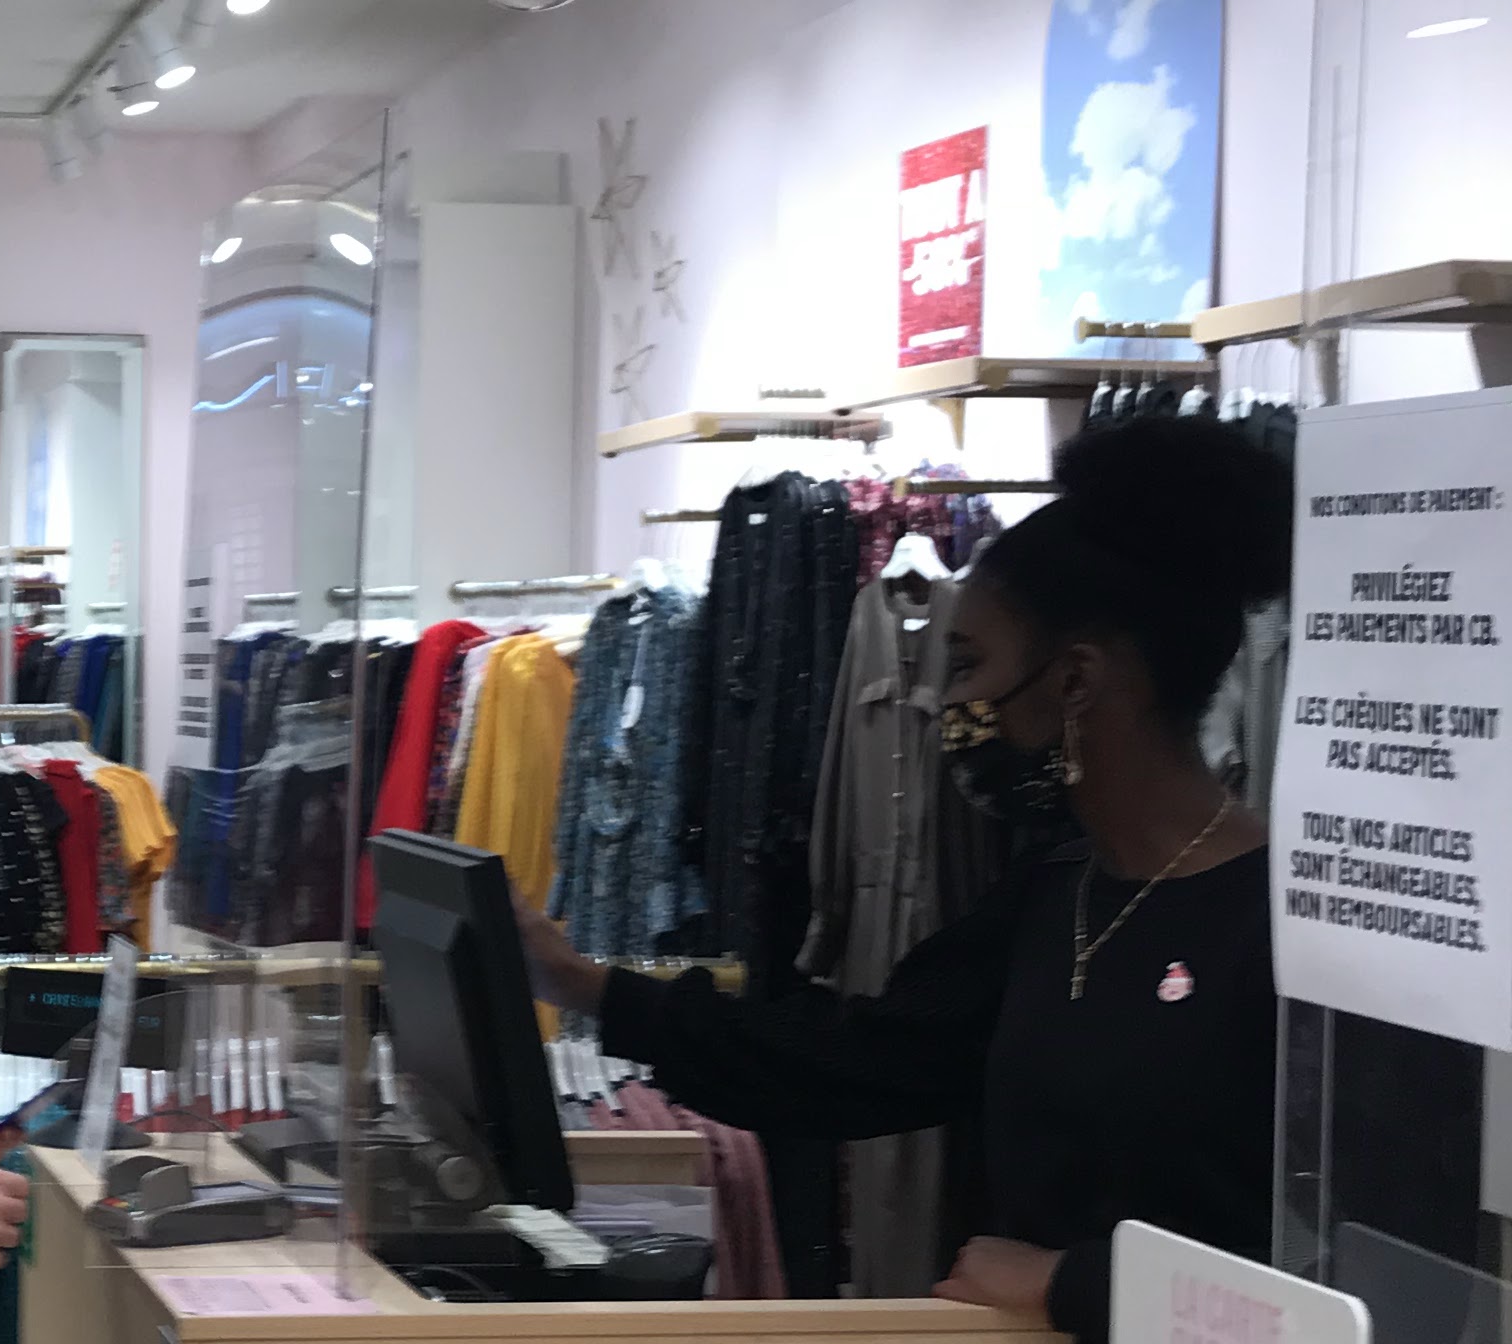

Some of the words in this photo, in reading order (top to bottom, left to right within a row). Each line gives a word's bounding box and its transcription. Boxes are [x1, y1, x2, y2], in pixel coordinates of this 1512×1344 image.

[1428, 486, 1494, 513] PAIEMENT
[1351, 562, 1455, 603] PRIVILÉGIEZ
[1305, 612, 1335, 641] LES
[1337, 613, 1428, 644] PAIEMENTS
[1431, 613, 1466, 645] PAR
[1295, 695, 1328, 726] LES
[1332, 691, 1414, 733] CHÈQUES
[1418, 703, 1445, 736] NE
[1448, 705, 1501, 739] SONT
[1325, 739, 1363, 771] PAS
[1302, 811, 1346, 845] TOUS
[1348, 817, 1386, 850] NOS
[1389, 822, 1475, 863] ARTICLES
[1290, 849, 1336, 883] SONT
[1285, 887, 1323, 921] NON
